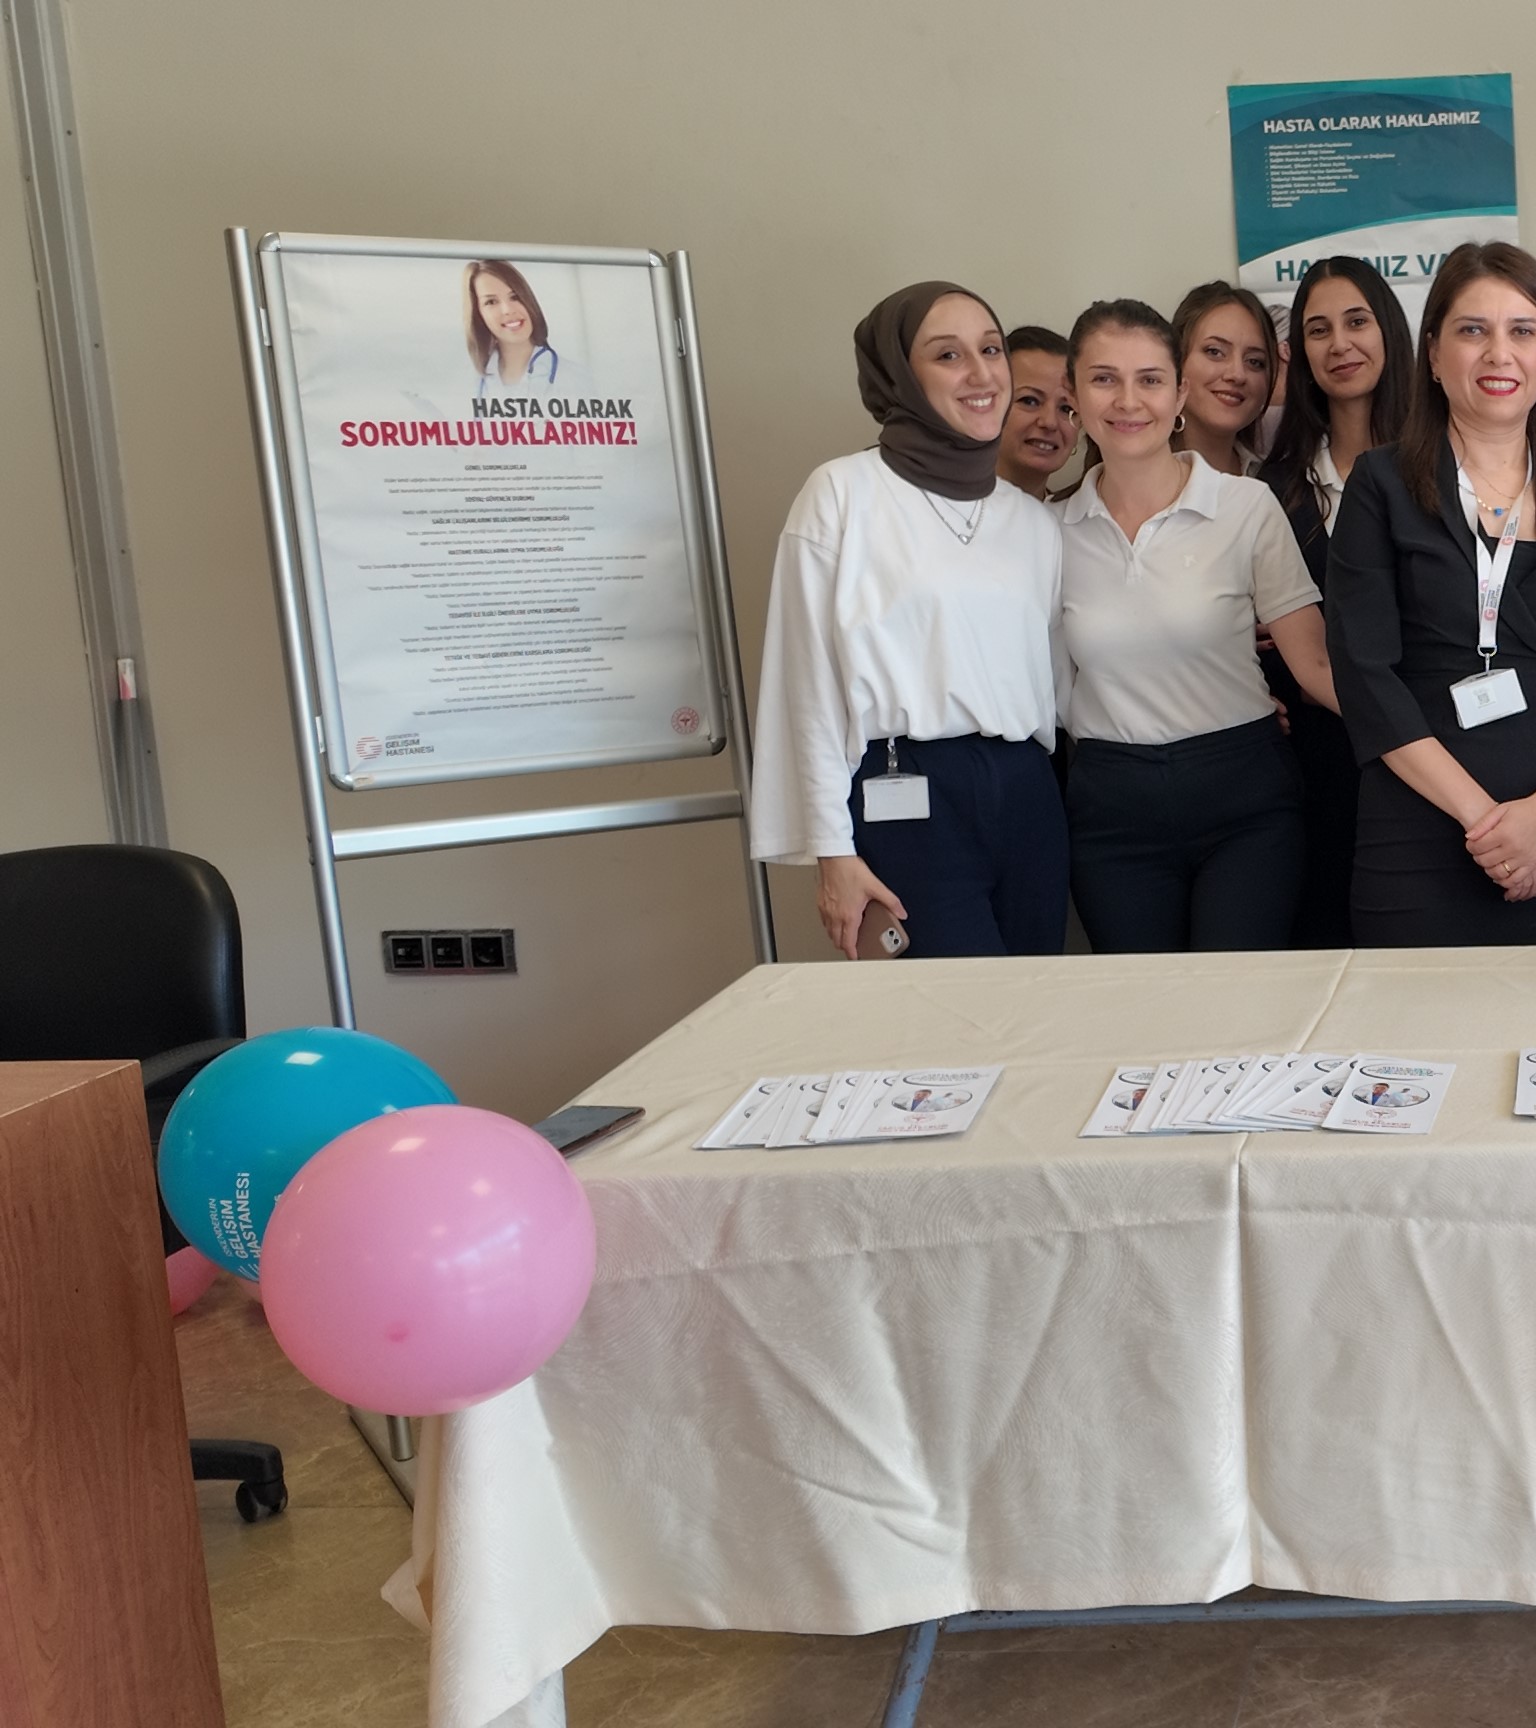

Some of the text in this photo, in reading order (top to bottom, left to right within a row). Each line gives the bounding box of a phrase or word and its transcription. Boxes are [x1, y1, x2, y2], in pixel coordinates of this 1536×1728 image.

[1264, 111, 1480, 133] HASTA OLARAK HAKLARIMIZ
[471, 397, 633, 420] HASTA OLARAK
[340, 420, 638, 448] SORUMLULUKLARINIZ!
